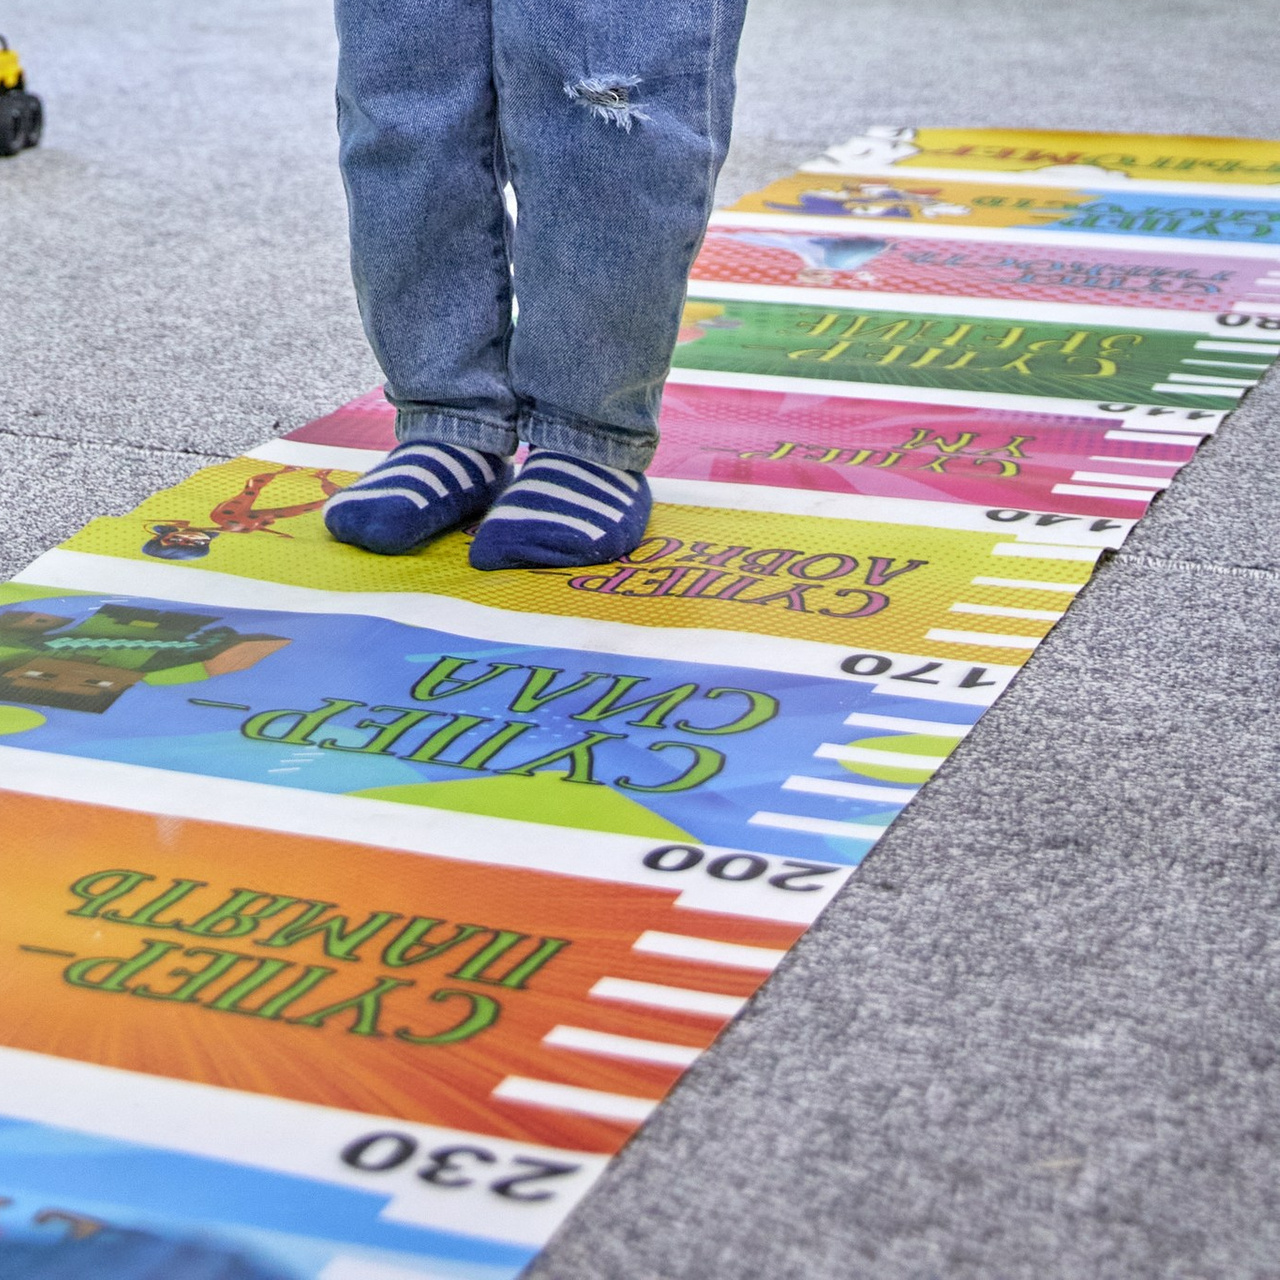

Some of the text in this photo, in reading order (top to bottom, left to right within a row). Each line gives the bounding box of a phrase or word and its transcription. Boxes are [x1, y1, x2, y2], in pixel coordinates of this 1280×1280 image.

[744, 340, 1119, 378] СУПЕР-
[779, 312, 1146, 360] ЗРЕНИЕ
[698, 441, 1022, 478] СУПЕР-
[901, 427, 1037, 460] УМ
[528, 565, 891, 619] СУПЕР-
[409, 654, 781, 737] СИЛА
[840, 652, 999, 691] 170
[188, 696, 728, 794] СУПЕР-
[642, 844, 843, 893] 200
[66, 868, 572, 990] ПАМЯТЬ
[19, 937, 503, 1047] СУПЕР-
[338, 1129, 584, 1204] 230
